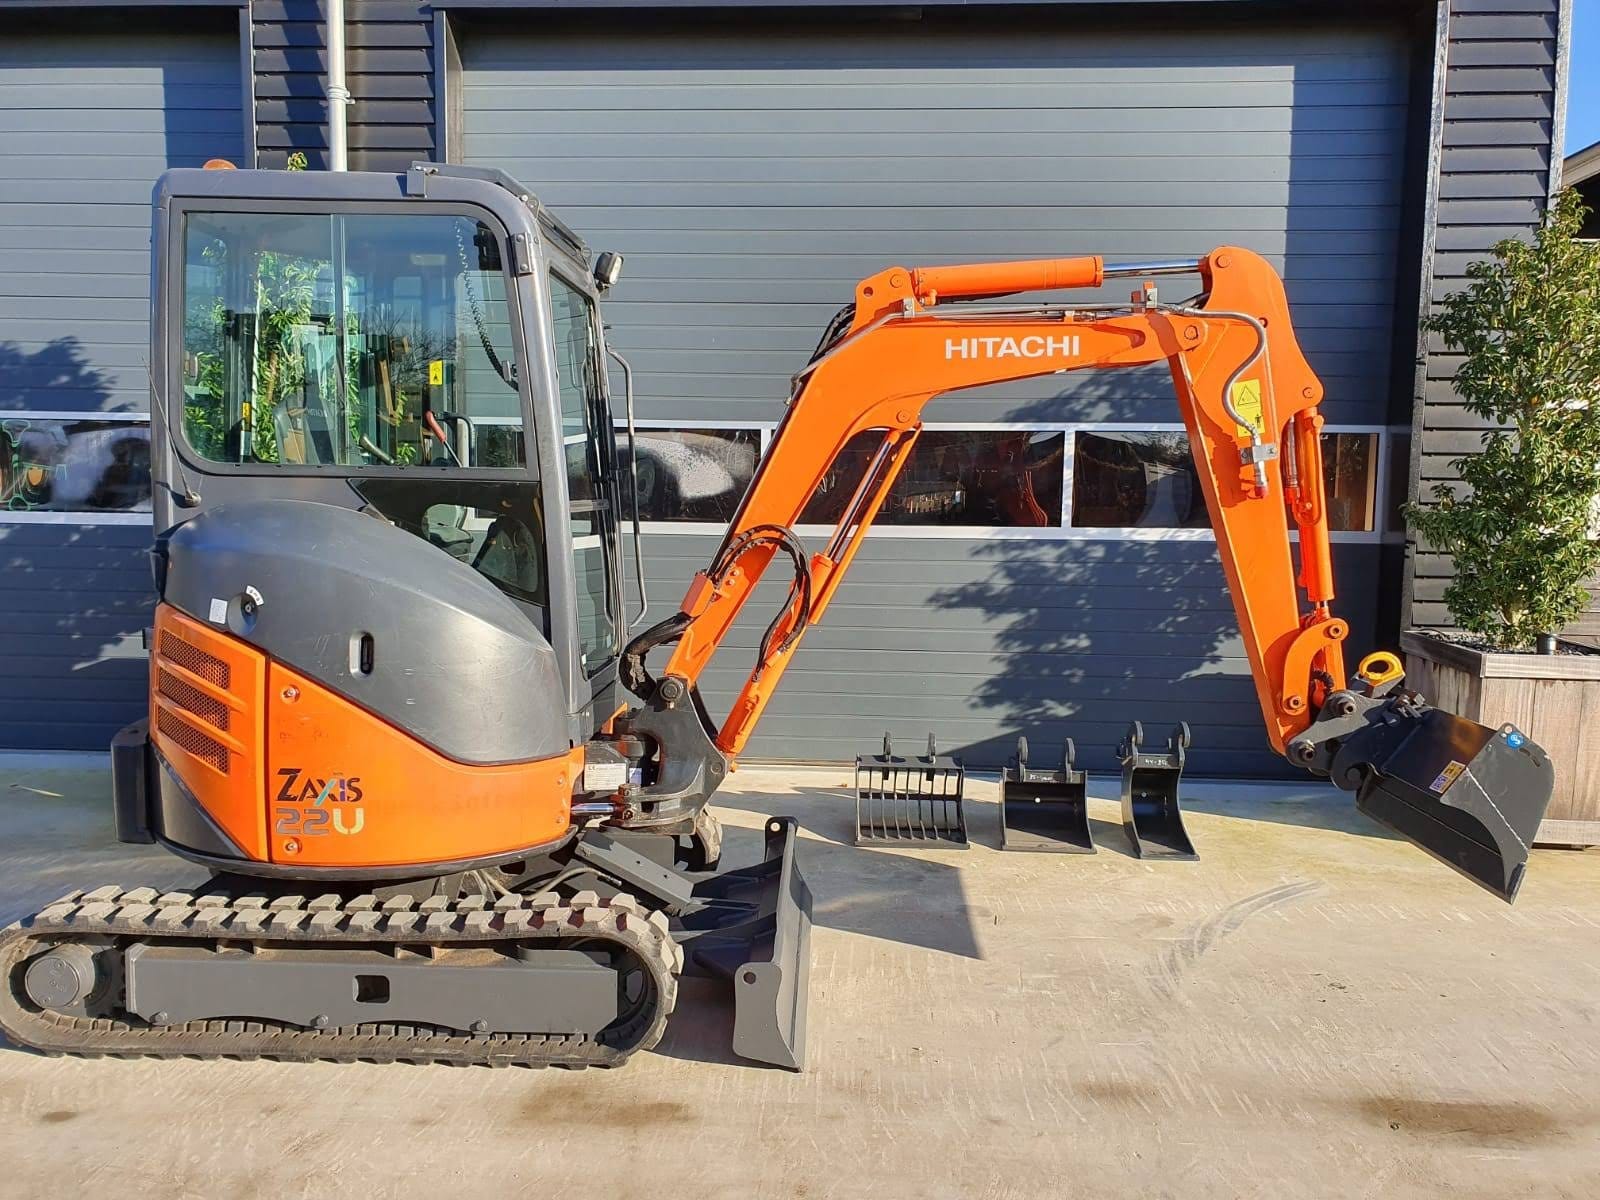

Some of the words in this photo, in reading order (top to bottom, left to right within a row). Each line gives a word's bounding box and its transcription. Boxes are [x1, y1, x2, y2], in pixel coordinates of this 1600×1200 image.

[945, 335, 1080, 359] HITACHI
[276, 767, 363, 806] ZAXIS
[275, 807, 364, 835] 22U
